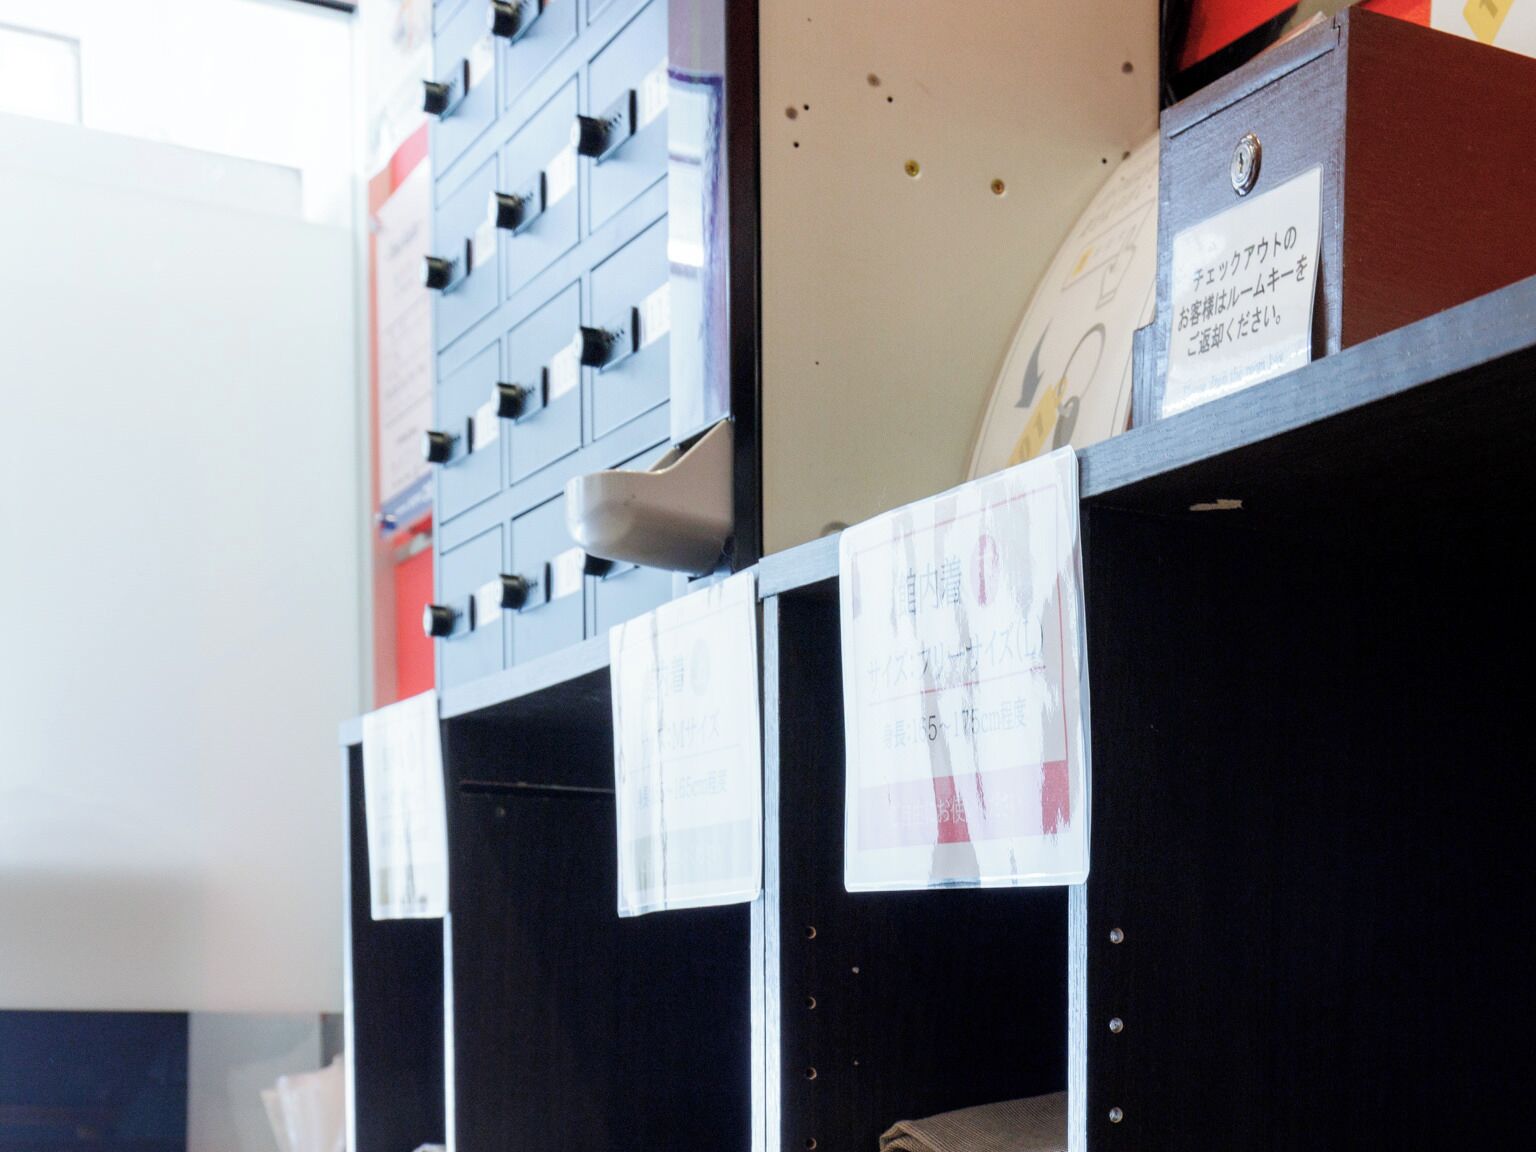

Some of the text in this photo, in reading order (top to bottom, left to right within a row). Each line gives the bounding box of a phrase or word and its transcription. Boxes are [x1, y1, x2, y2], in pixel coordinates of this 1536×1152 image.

[1193, 226, 1297, 291] チェックアウトの
[1177, 255, 1308, 332] お客様はルームキーを
[1187, 304, 1281, 356] ご返却ください。
